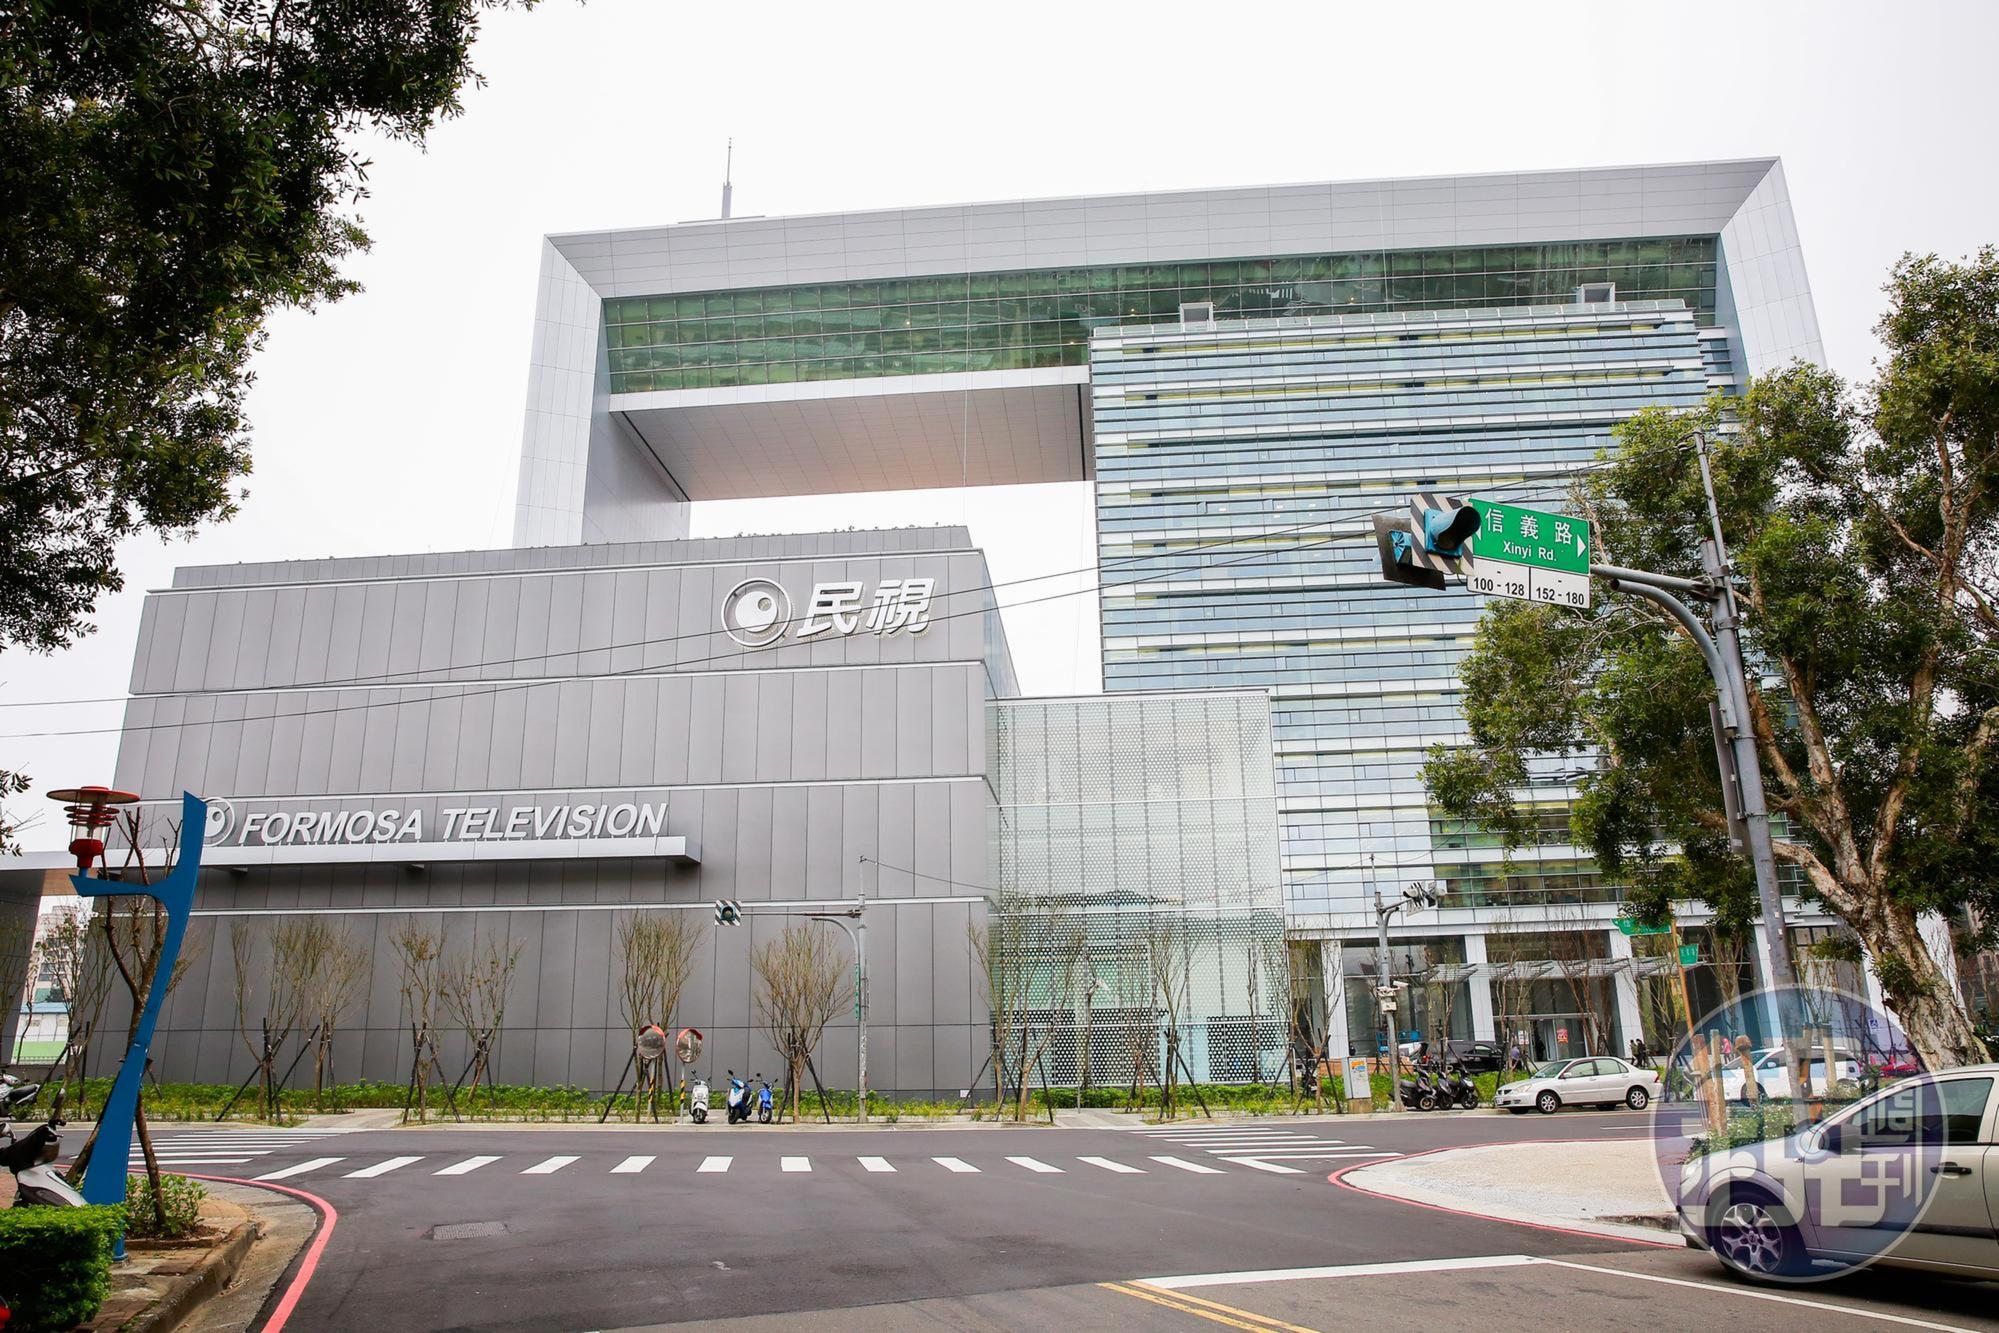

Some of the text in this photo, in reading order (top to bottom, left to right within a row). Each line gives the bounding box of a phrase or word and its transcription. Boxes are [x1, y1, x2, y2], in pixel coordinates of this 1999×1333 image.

[1485, 507, 1573, 545] 信義路
[1503, 541, 1557, 562] Xinyi Rd.
[1473, 577, 1494, 592] 100
[1505, 582, 1525, 597] 128
[1536, 587, 1555, 600] 152
[1566, 591, 1585, 605] 180
[796, 577, 935, 639] 民視
[239, 802, 668, 844] FORMOSA TELEVISION
